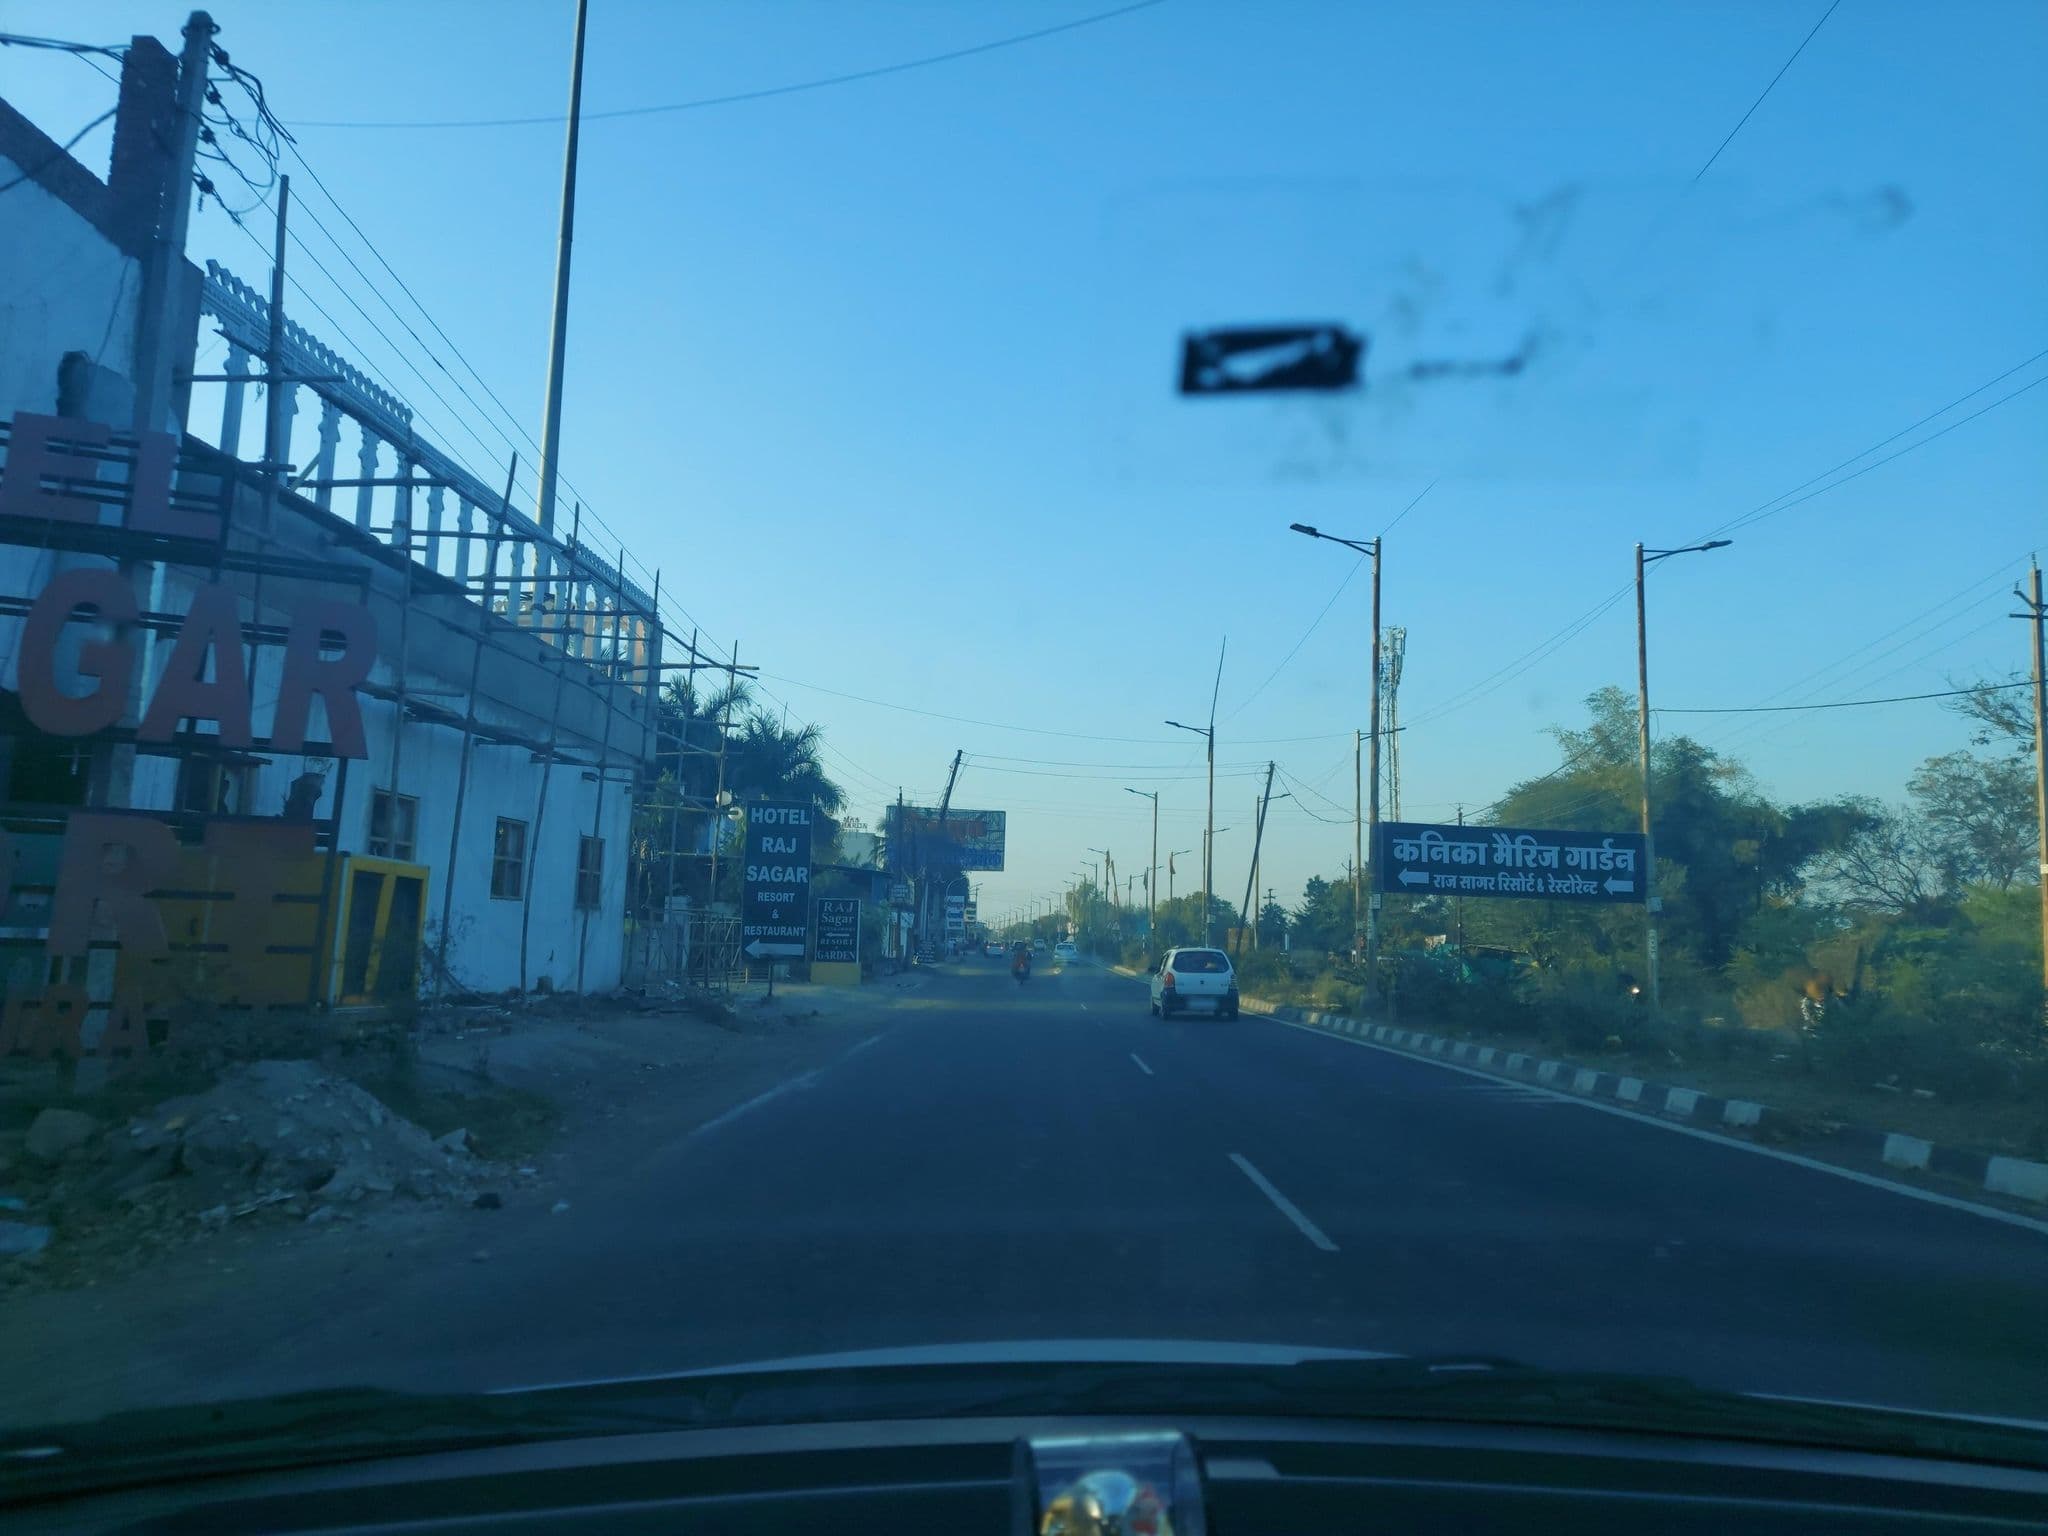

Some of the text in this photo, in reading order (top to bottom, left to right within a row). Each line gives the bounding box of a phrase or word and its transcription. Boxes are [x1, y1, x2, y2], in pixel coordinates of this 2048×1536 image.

[19, 569, 374, 759] GAR
[751, 807, 810, 825] HOTEL
[761, 835, 797, 854] RAJ
[1392, 830, 1636, 873] कनिका मैरिज गार्डन
[746, 865, 809, 883] SAGAR
[1433, 873, 1457, 889] राज
[1459, 874, 1495, 891] सागर
[1497, 872, 1534, 893] रिसोर्ट
[757, 891, 795, 903] RESORT
[771, 908, 780, 919] &
[821, 914, 855, 927] Sagar
[744, 926, 806, 937] RESTAURANT
